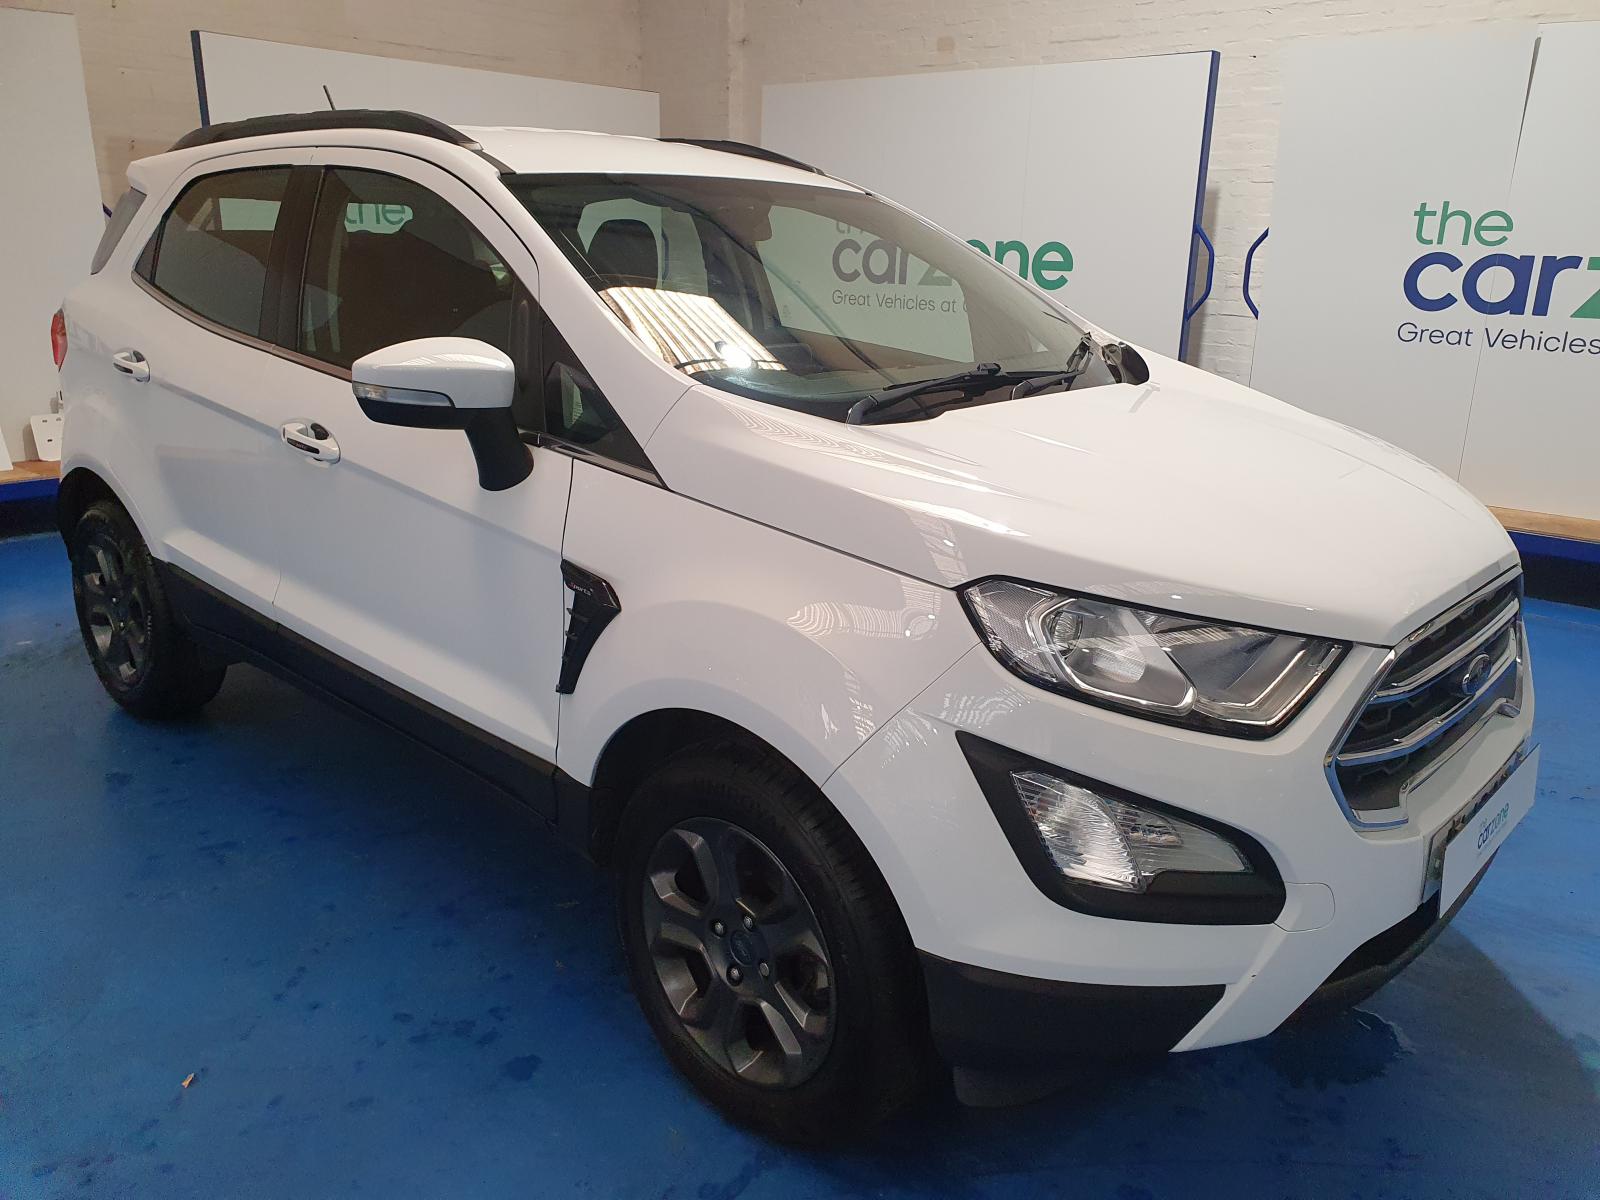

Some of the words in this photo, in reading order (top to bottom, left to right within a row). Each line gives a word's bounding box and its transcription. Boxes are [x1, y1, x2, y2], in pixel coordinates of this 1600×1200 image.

[1413, 201, 1514, 247] the
[832, 290, 871, 307] Great
[876, 292, 936, 311] Vehicles
[941, 299, 957, 313] at
[1397, 322, 1474, 347] Great
[1485, 327, 1600, 355] Vehicles
